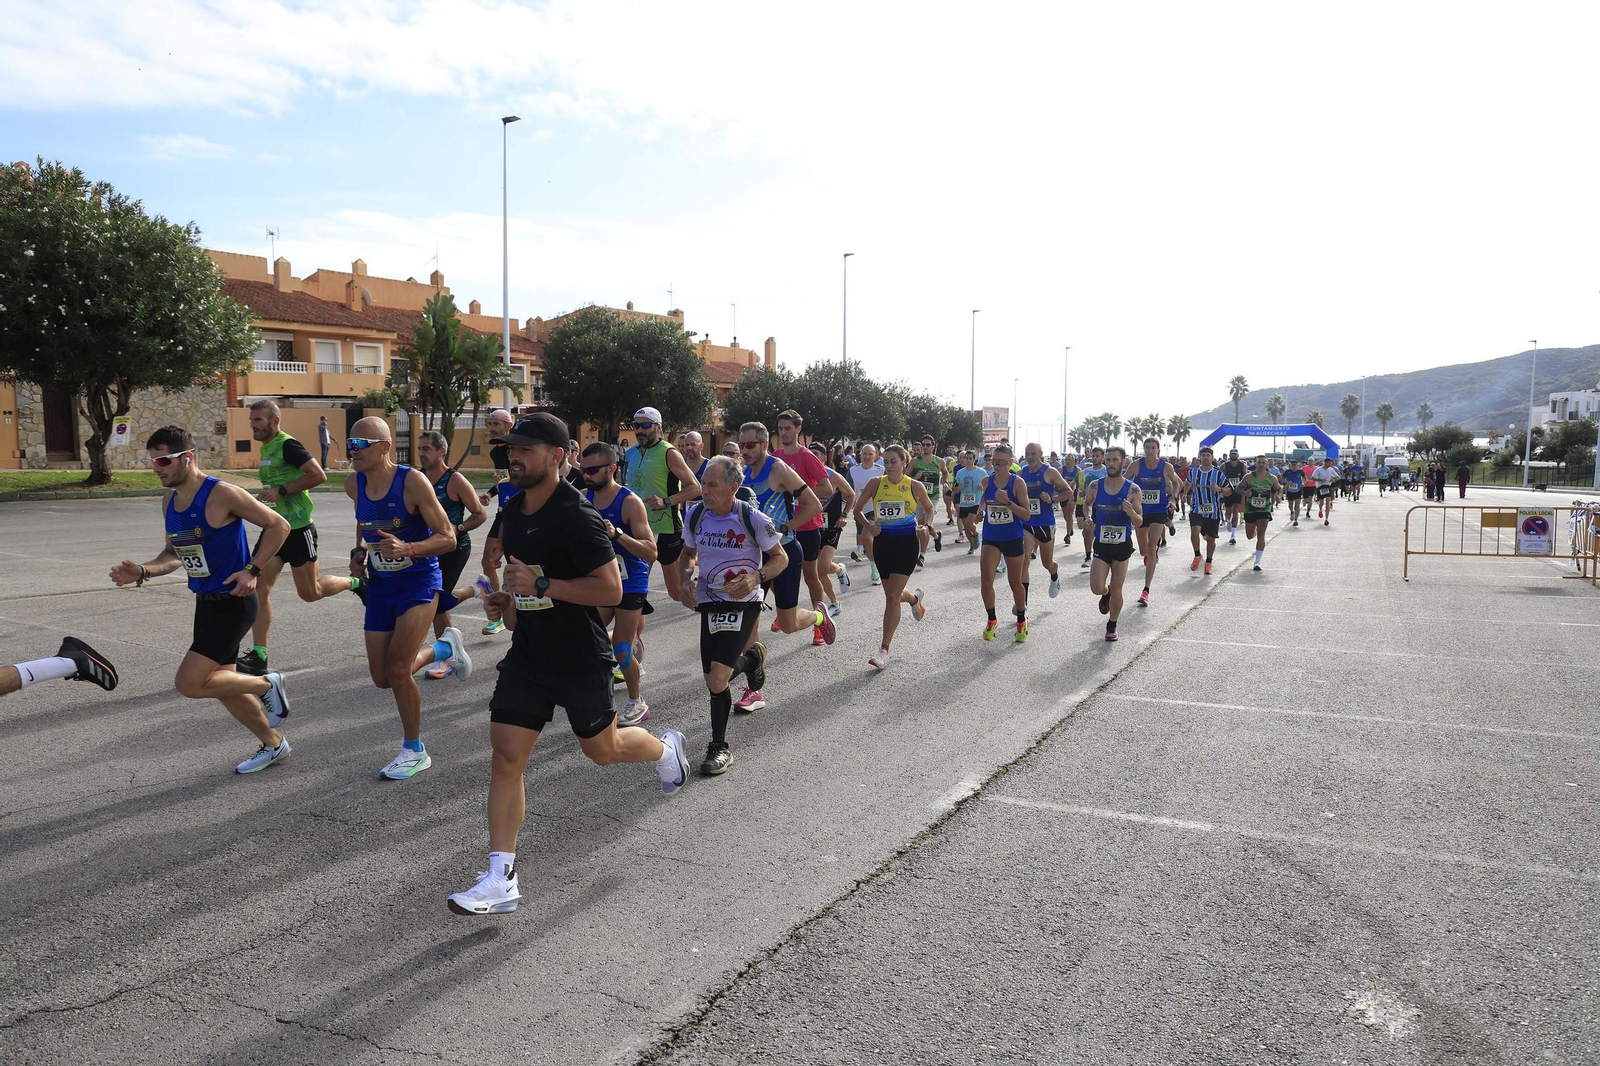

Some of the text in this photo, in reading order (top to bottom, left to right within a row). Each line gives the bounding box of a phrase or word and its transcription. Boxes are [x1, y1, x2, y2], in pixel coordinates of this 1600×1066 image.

[879, 507, 902, 517] 387
[990, 511, 1010, 520] 475
[1103, 531, 1123, 540] 257
[707, 537, 744, 550] Valentina
[710, 612, 739, 623] 450
